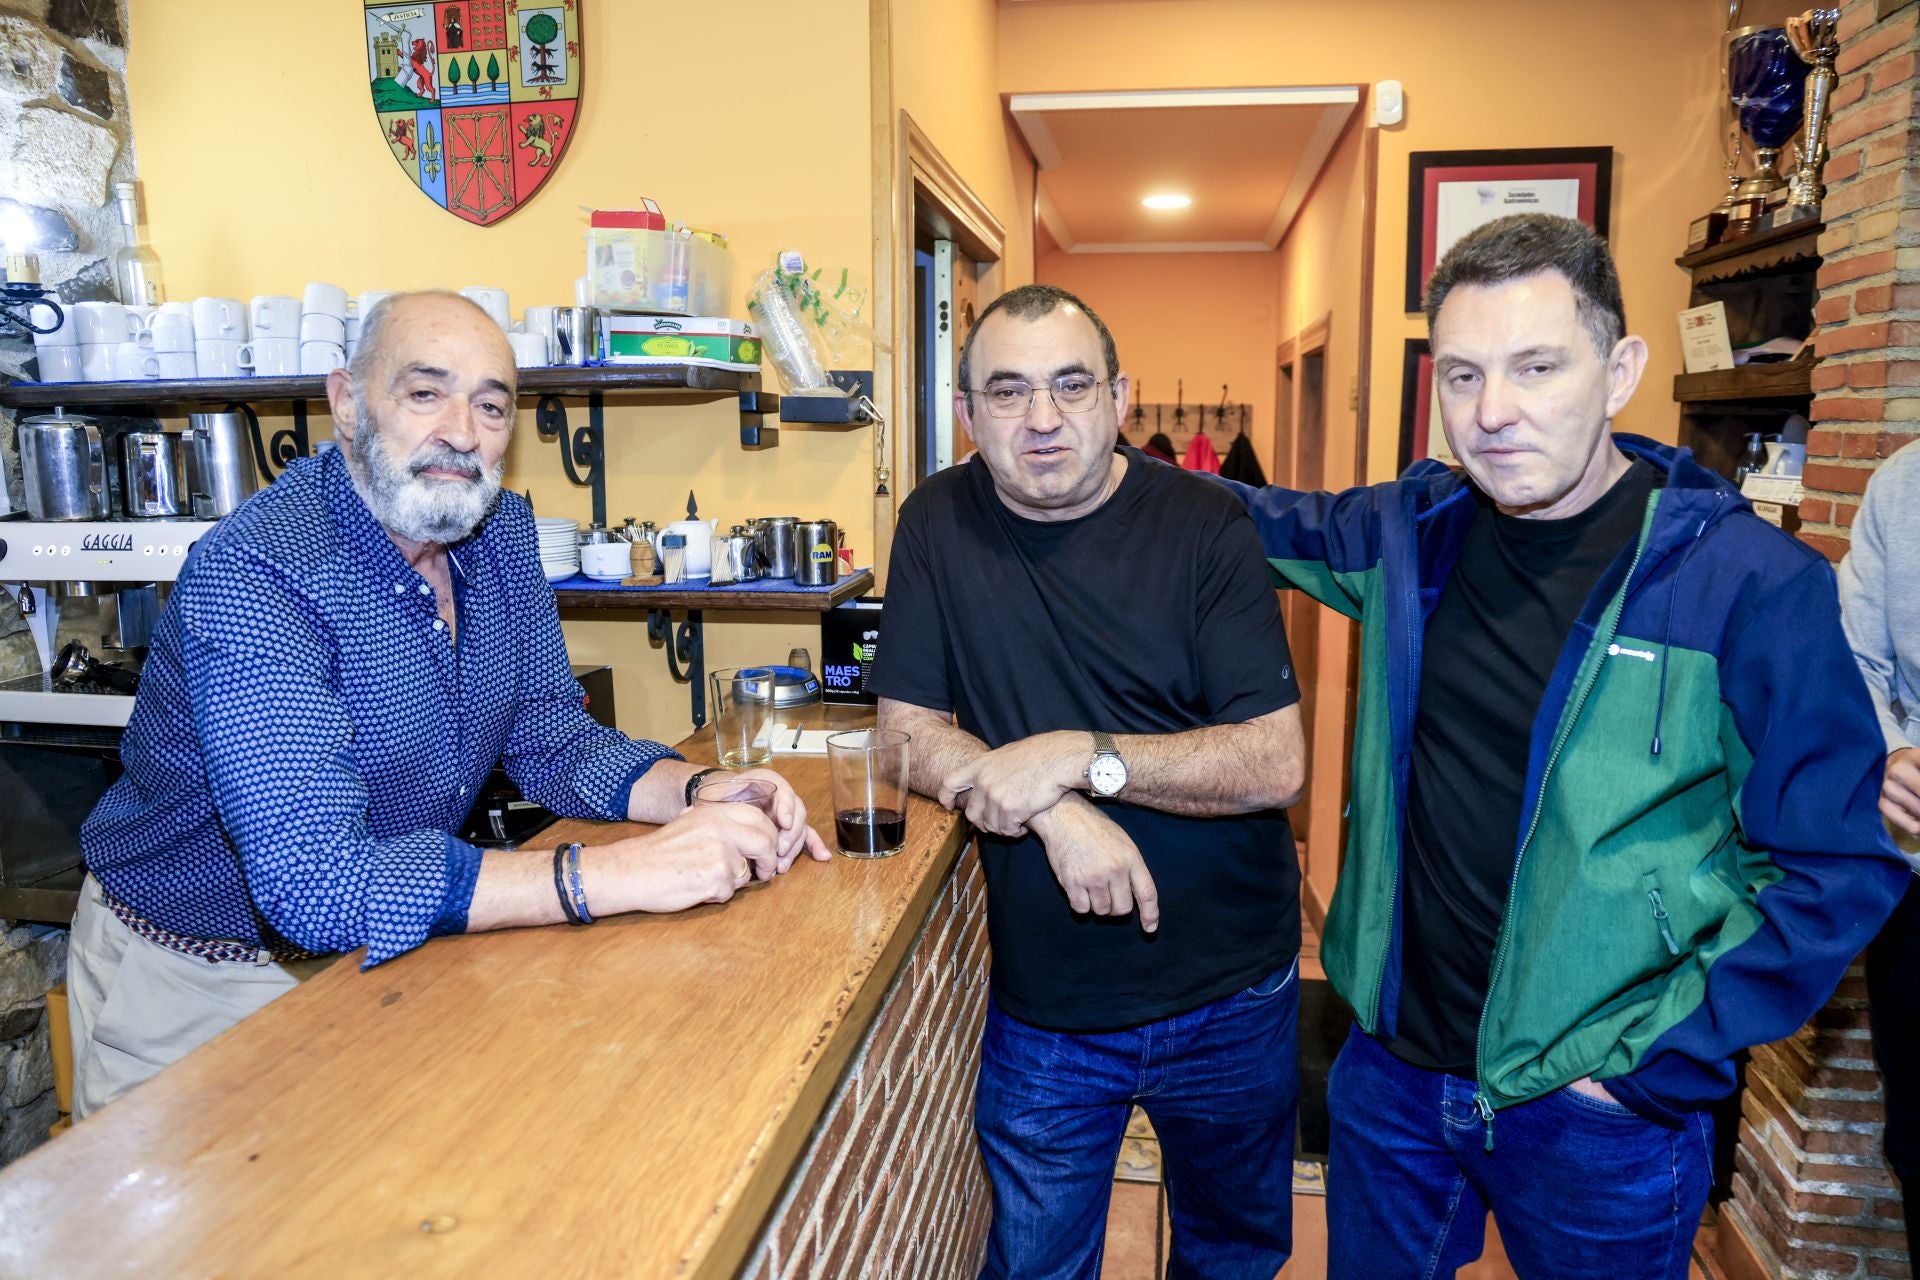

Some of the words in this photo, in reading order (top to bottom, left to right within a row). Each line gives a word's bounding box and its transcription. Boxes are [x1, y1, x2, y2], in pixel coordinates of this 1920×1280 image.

[83, 534, 133, 551] GAGGIA
[812, 551, 832, 559] RAM
[825, 665, 860, 677] MAES
[825, 676, 851, 687] TRO
